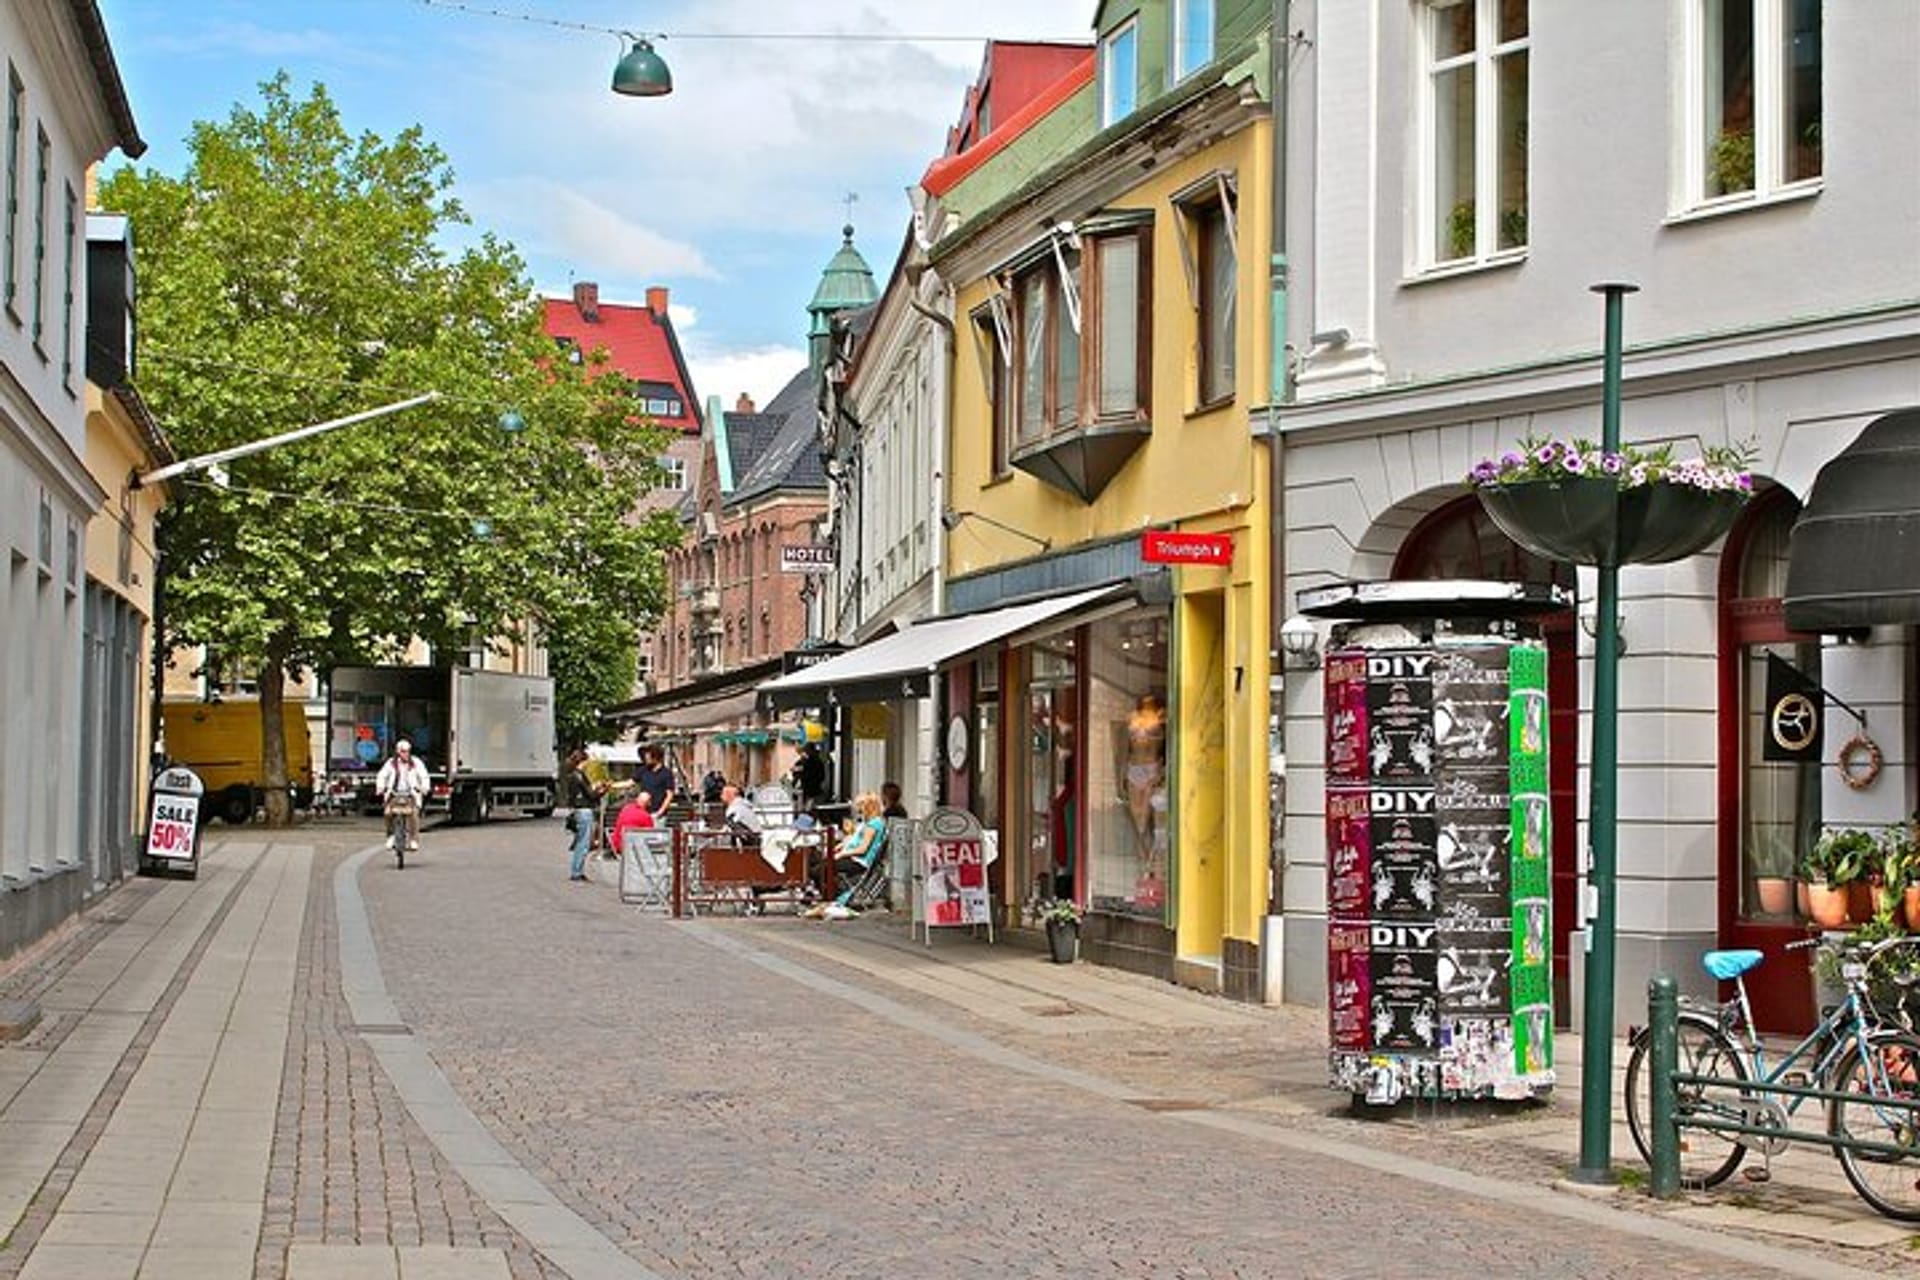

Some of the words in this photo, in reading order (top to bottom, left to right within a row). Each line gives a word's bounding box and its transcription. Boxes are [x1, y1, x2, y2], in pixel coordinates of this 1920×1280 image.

[786, 547, 832, 561] HOTEL
[1156, 541, 1211, 560] Triumph
[1368, 656, 1432, 676] DIY
[1371, 791, 1435, 812] DIY
[156, 805, 193, 824] SALE
[152, 823, 191, 852] 50%
[925, 841, 981, 867] REA!
[1371, 927, 1436, 948] DIY
